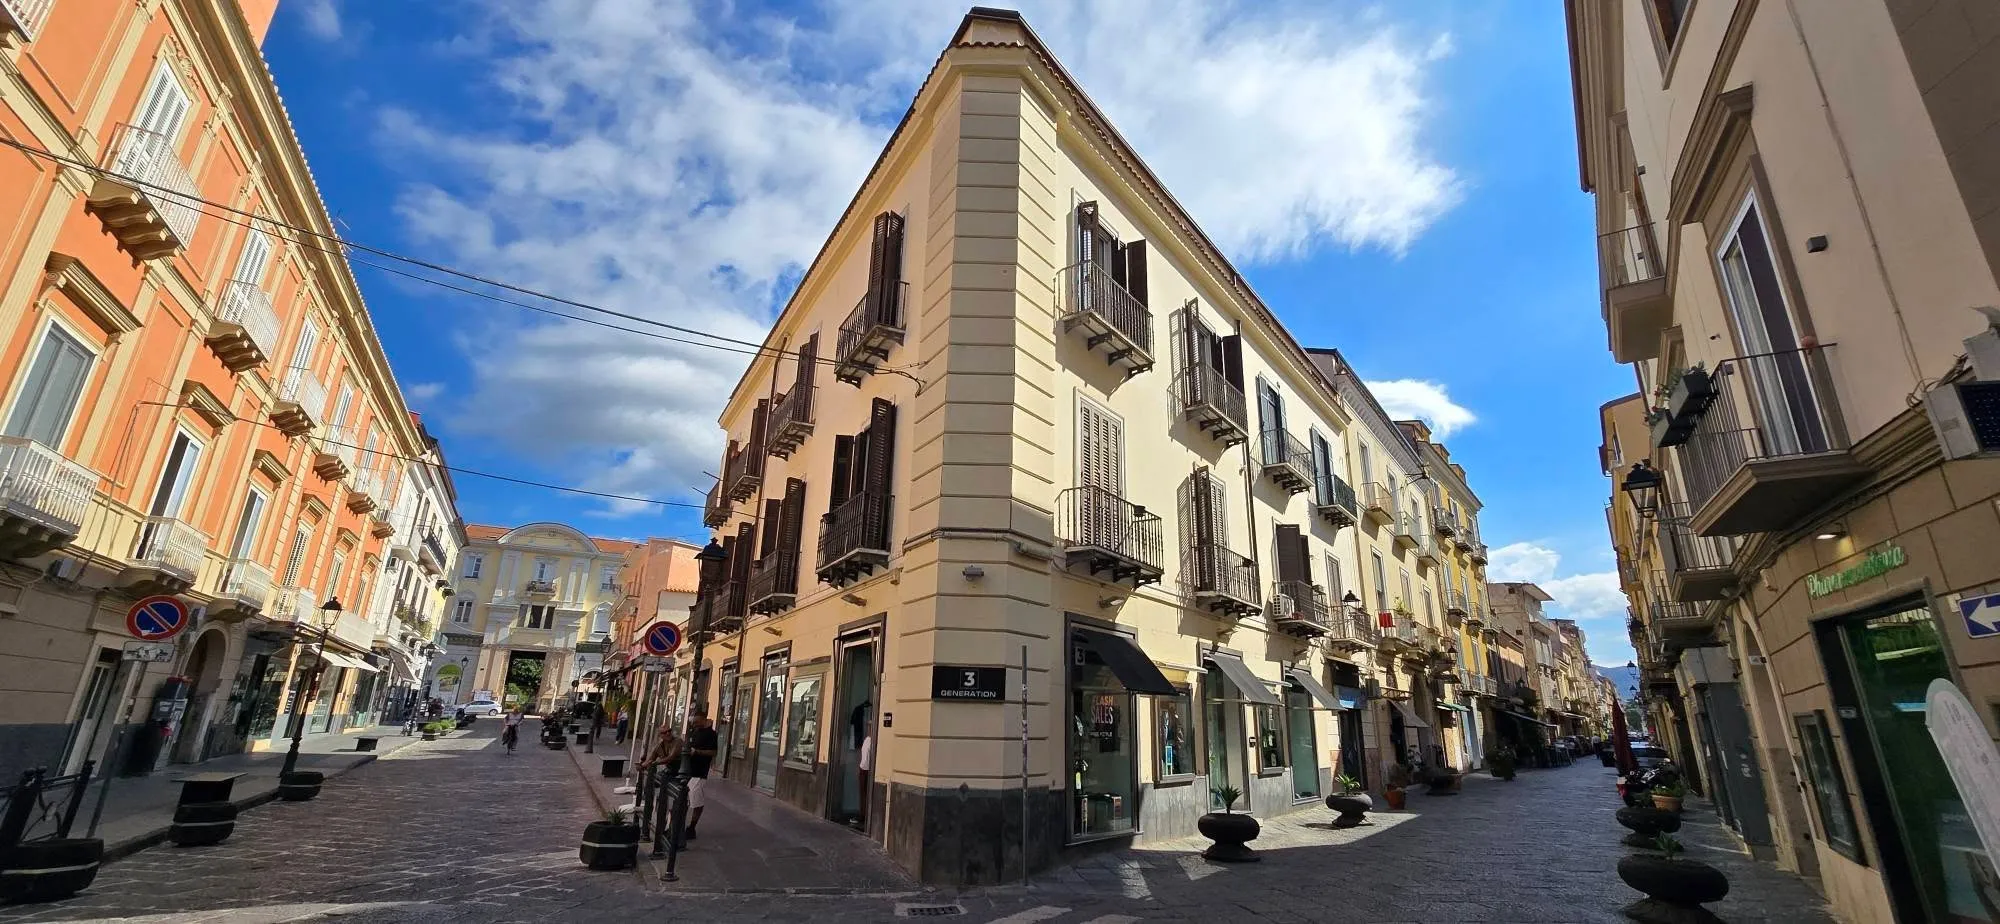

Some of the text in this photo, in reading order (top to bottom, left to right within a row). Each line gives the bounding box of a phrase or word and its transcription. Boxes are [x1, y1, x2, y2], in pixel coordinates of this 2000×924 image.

[964, 671, 975, 686] 3
[940, 689, 997, 698] GENERATION
[1091, 705, 1114, 725] SALES
